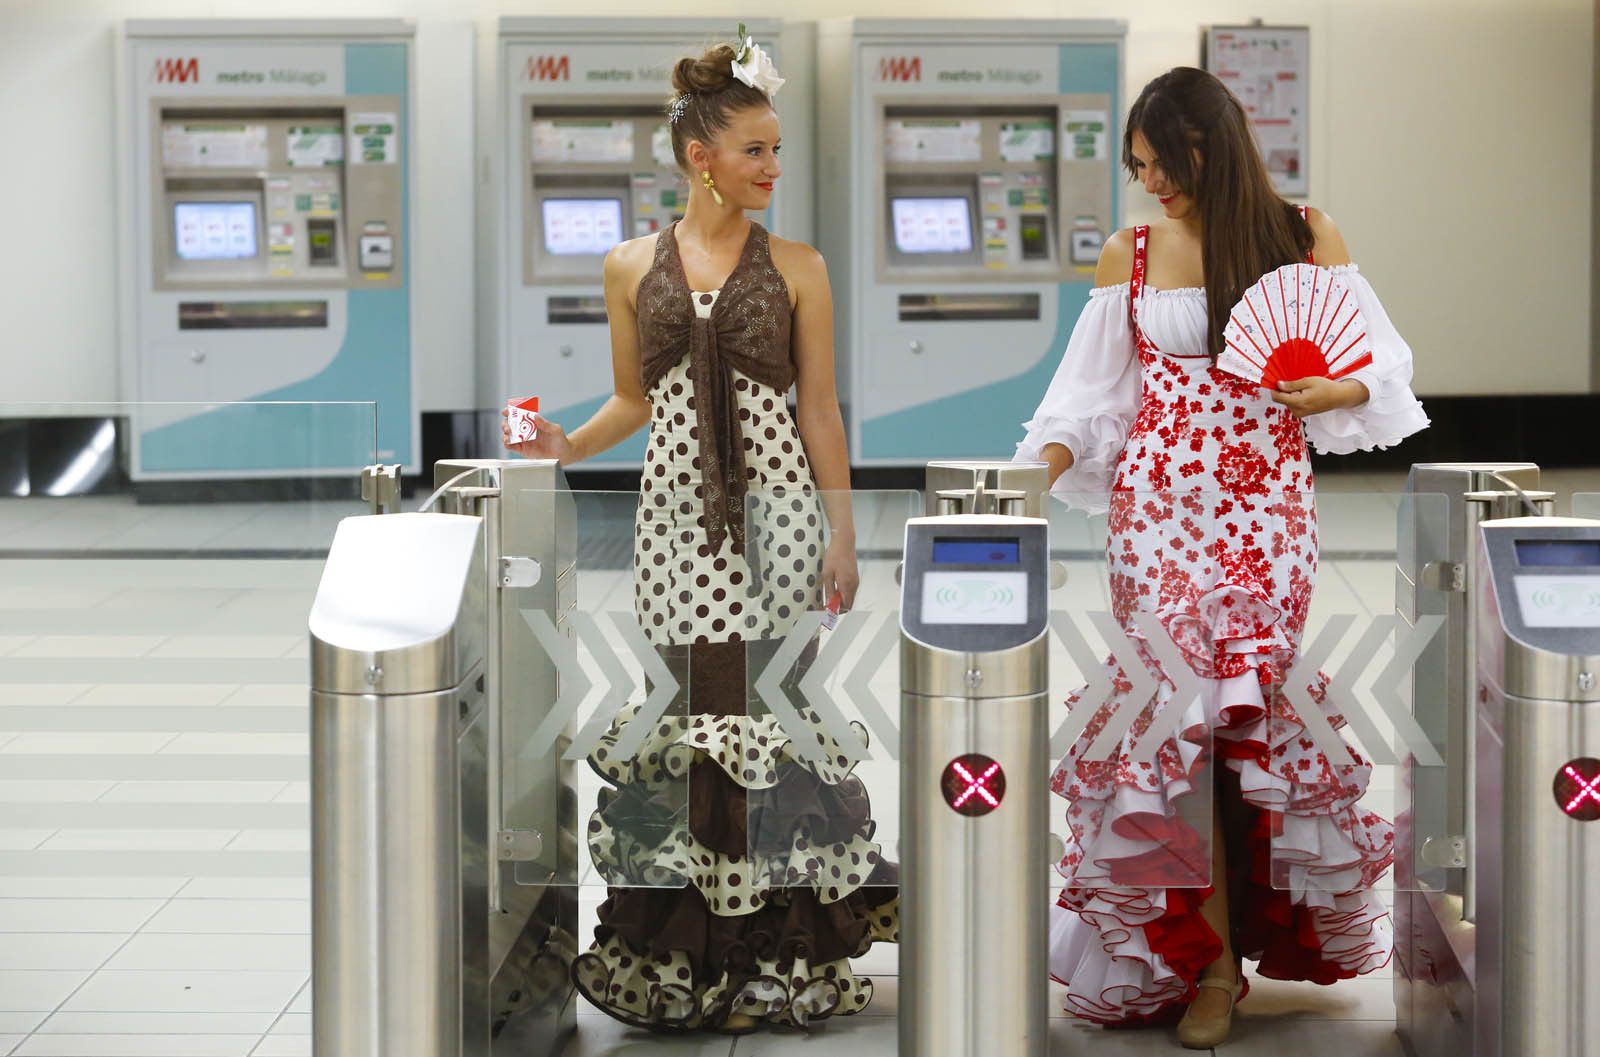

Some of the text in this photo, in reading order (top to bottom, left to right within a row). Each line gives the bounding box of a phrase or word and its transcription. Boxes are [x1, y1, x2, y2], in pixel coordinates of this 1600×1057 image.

[217, 69, 264, 82] metro
[586, 68, 634, 81] metro
[937, 69, 984, 81] metro
